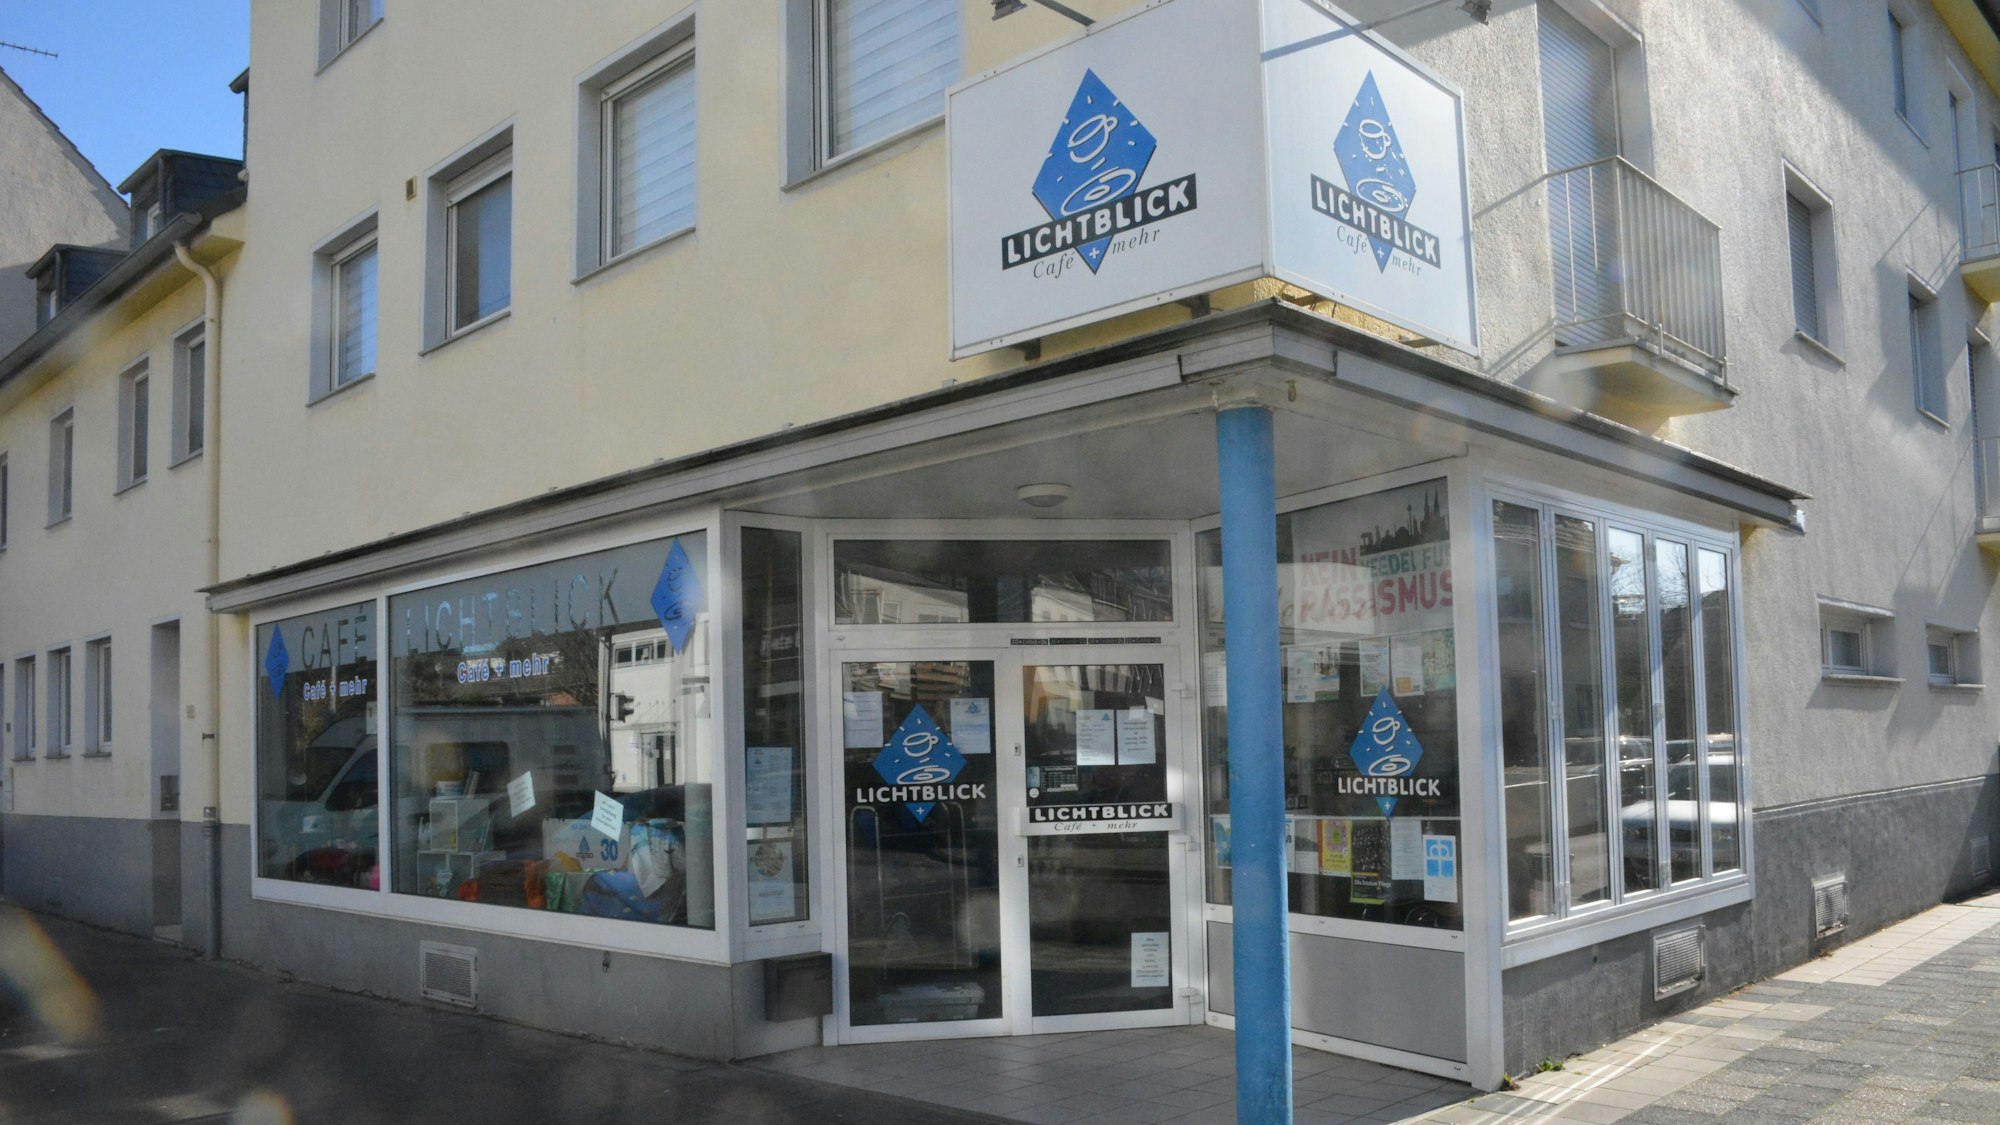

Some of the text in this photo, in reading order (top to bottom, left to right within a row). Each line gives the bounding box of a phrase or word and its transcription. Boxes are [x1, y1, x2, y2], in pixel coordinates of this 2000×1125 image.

[1007, 179, 1190, 264] LICHTBLICK
[1315, 180, 1437, 263] LICHTBLICK
[1033, 251, 1076, 279] Café
[1112, 228, 1160, 255] mehr
[1337, 225, 1368, 254] Café
[1392, 254, 1422, 276] mehr
[302, 567, 620, 671] CAFÉ LICHTBLICK
[457, 658, 490, 685] Café
[509, 652, 551, 680] mehr
[303, 679, 326, 701] Café
[339, 675, 368, 697] mehr
[856, 783, 986, 803] LICHTBLICK
[1338, 777, 1441, 796] LICHTBLICK
[1034, 804, 1169, 821] LICHTBLICK
[1054, 821, 1083, 832] Café
[1107, 819, 1139, 830] mehr
[600, 838, 619, 861] 30
